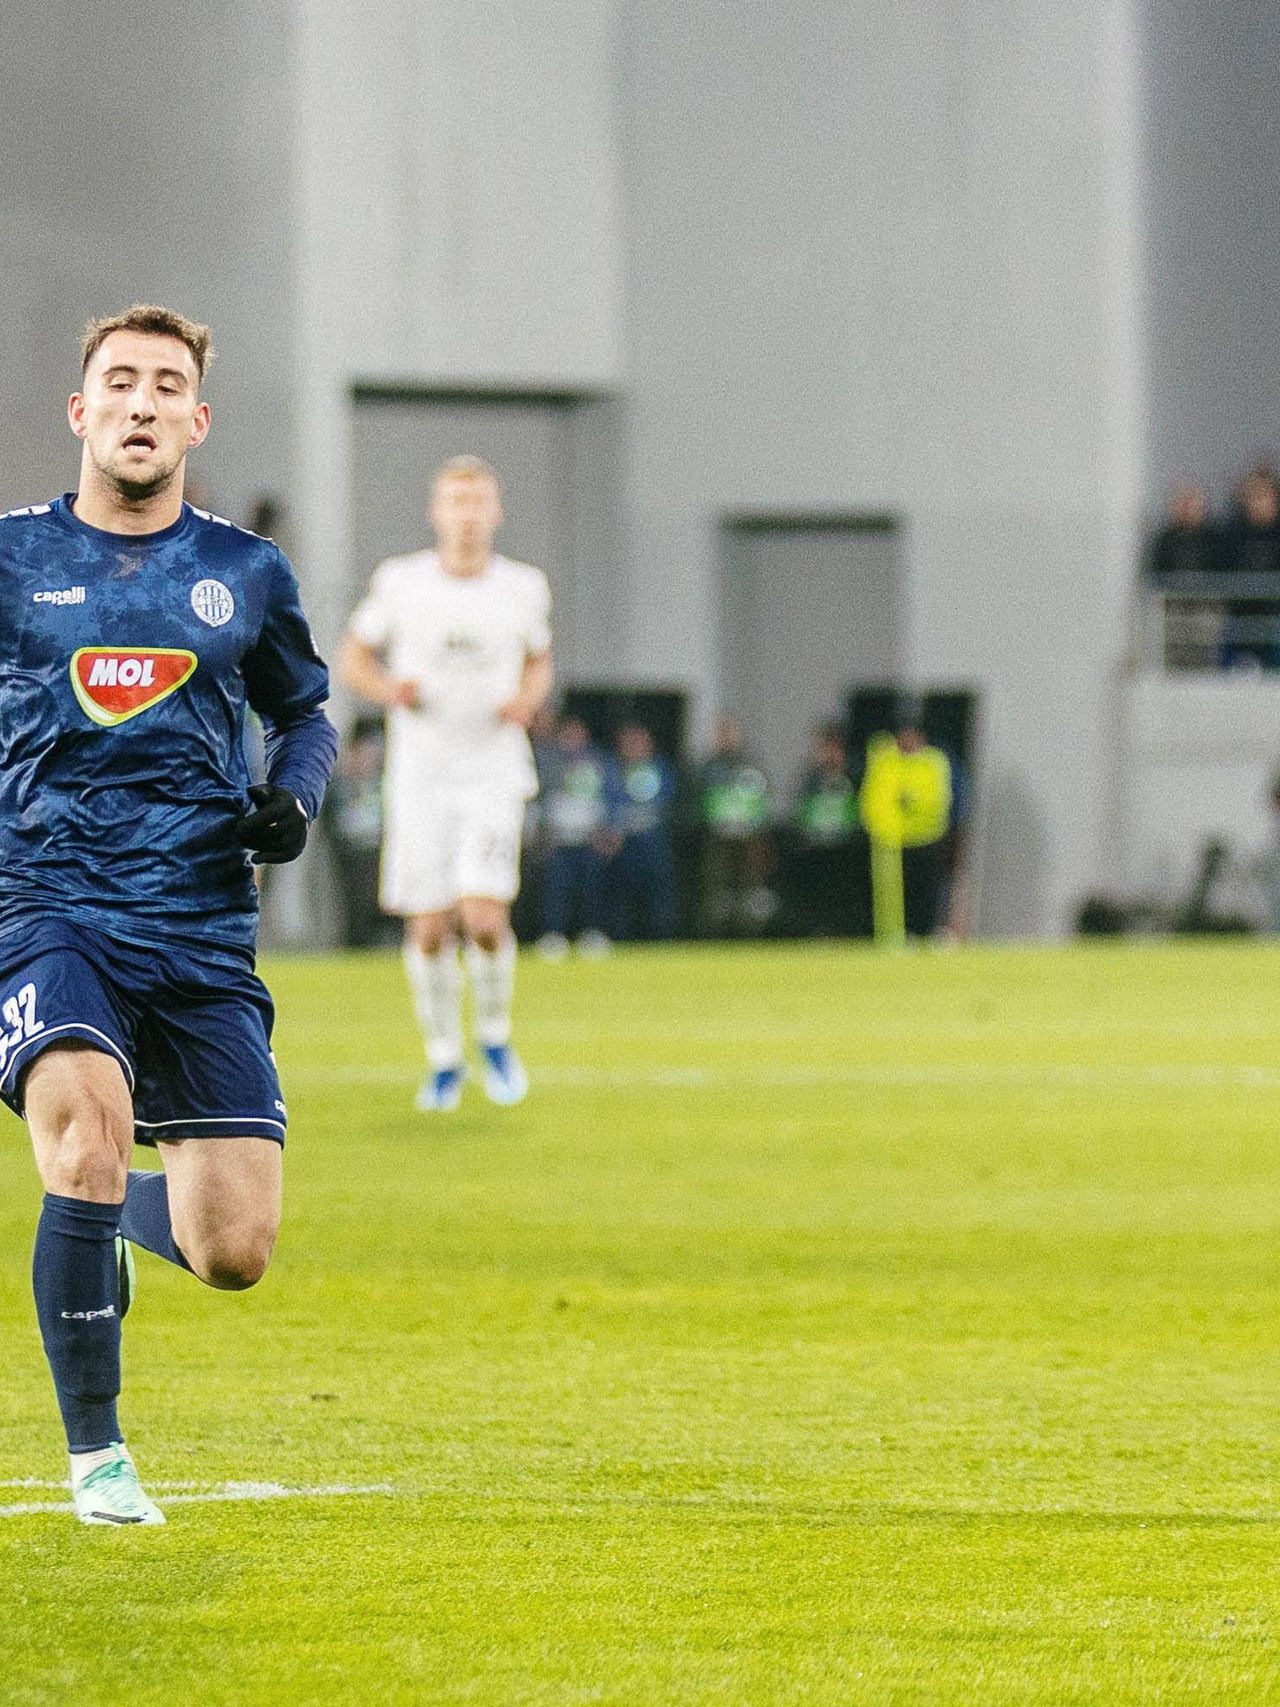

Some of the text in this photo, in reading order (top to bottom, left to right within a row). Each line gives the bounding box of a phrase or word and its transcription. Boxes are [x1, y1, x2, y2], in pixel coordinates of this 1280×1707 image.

[33, 586, 86, 604] capelli
[88, 658, 156, 687] MOL
[2, 982, 46, 1047] 32
